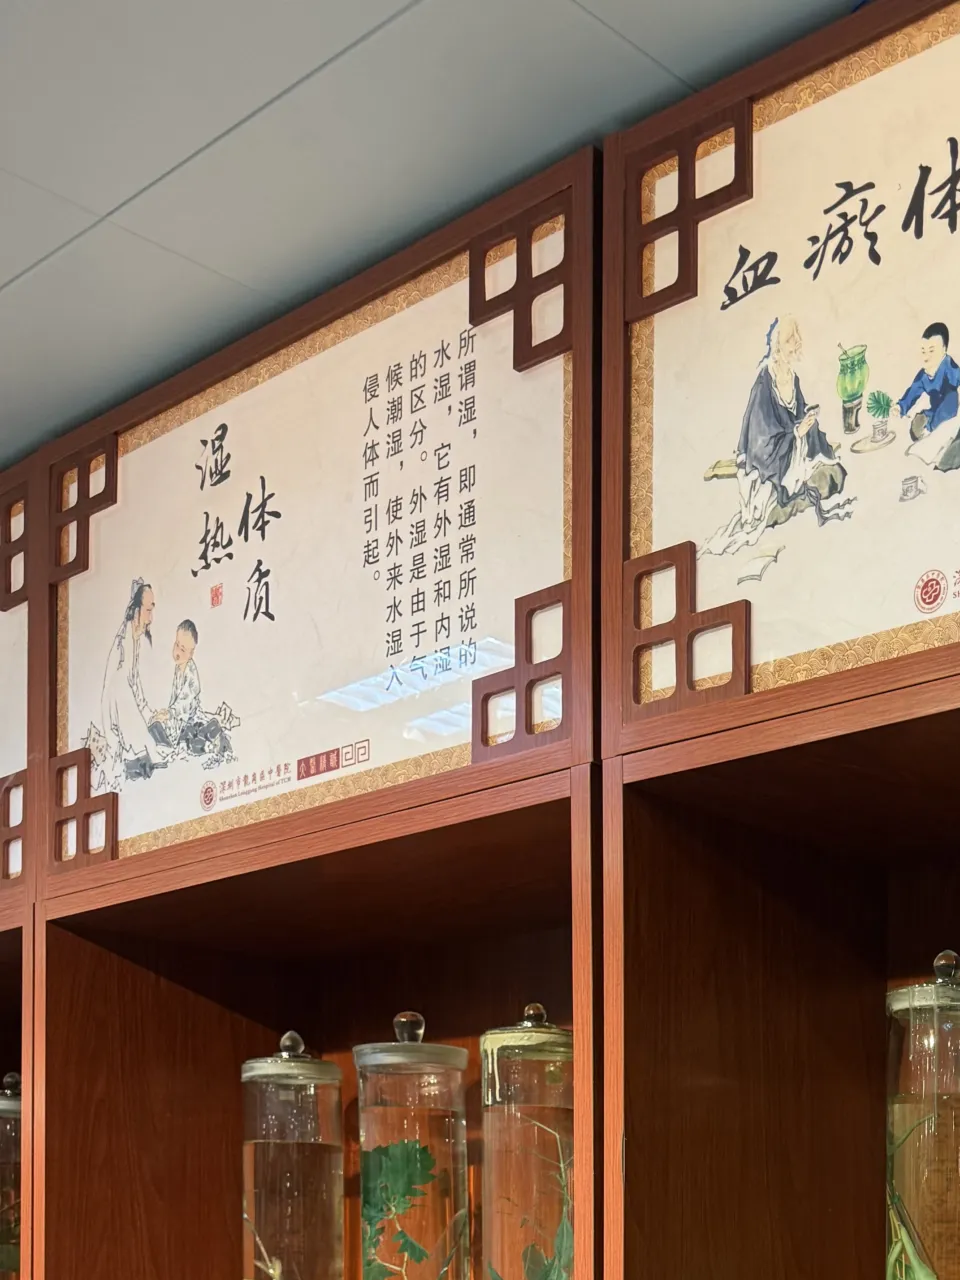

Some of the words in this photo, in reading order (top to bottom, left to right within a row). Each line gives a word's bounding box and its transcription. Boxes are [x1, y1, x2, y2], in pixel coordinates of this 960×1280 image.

[362, 373, 381, 581] 侵人体而引起。
[385, 362, 404, 692] 候潮湿，使外来水湿入
[409, 350, 427, 681] 的区分。外湿是由于气
[433, 339, 452, 676] 水湿，它有外湿和内湿
[457, 326, 477, 669] 所谓湿，即通常所说的
